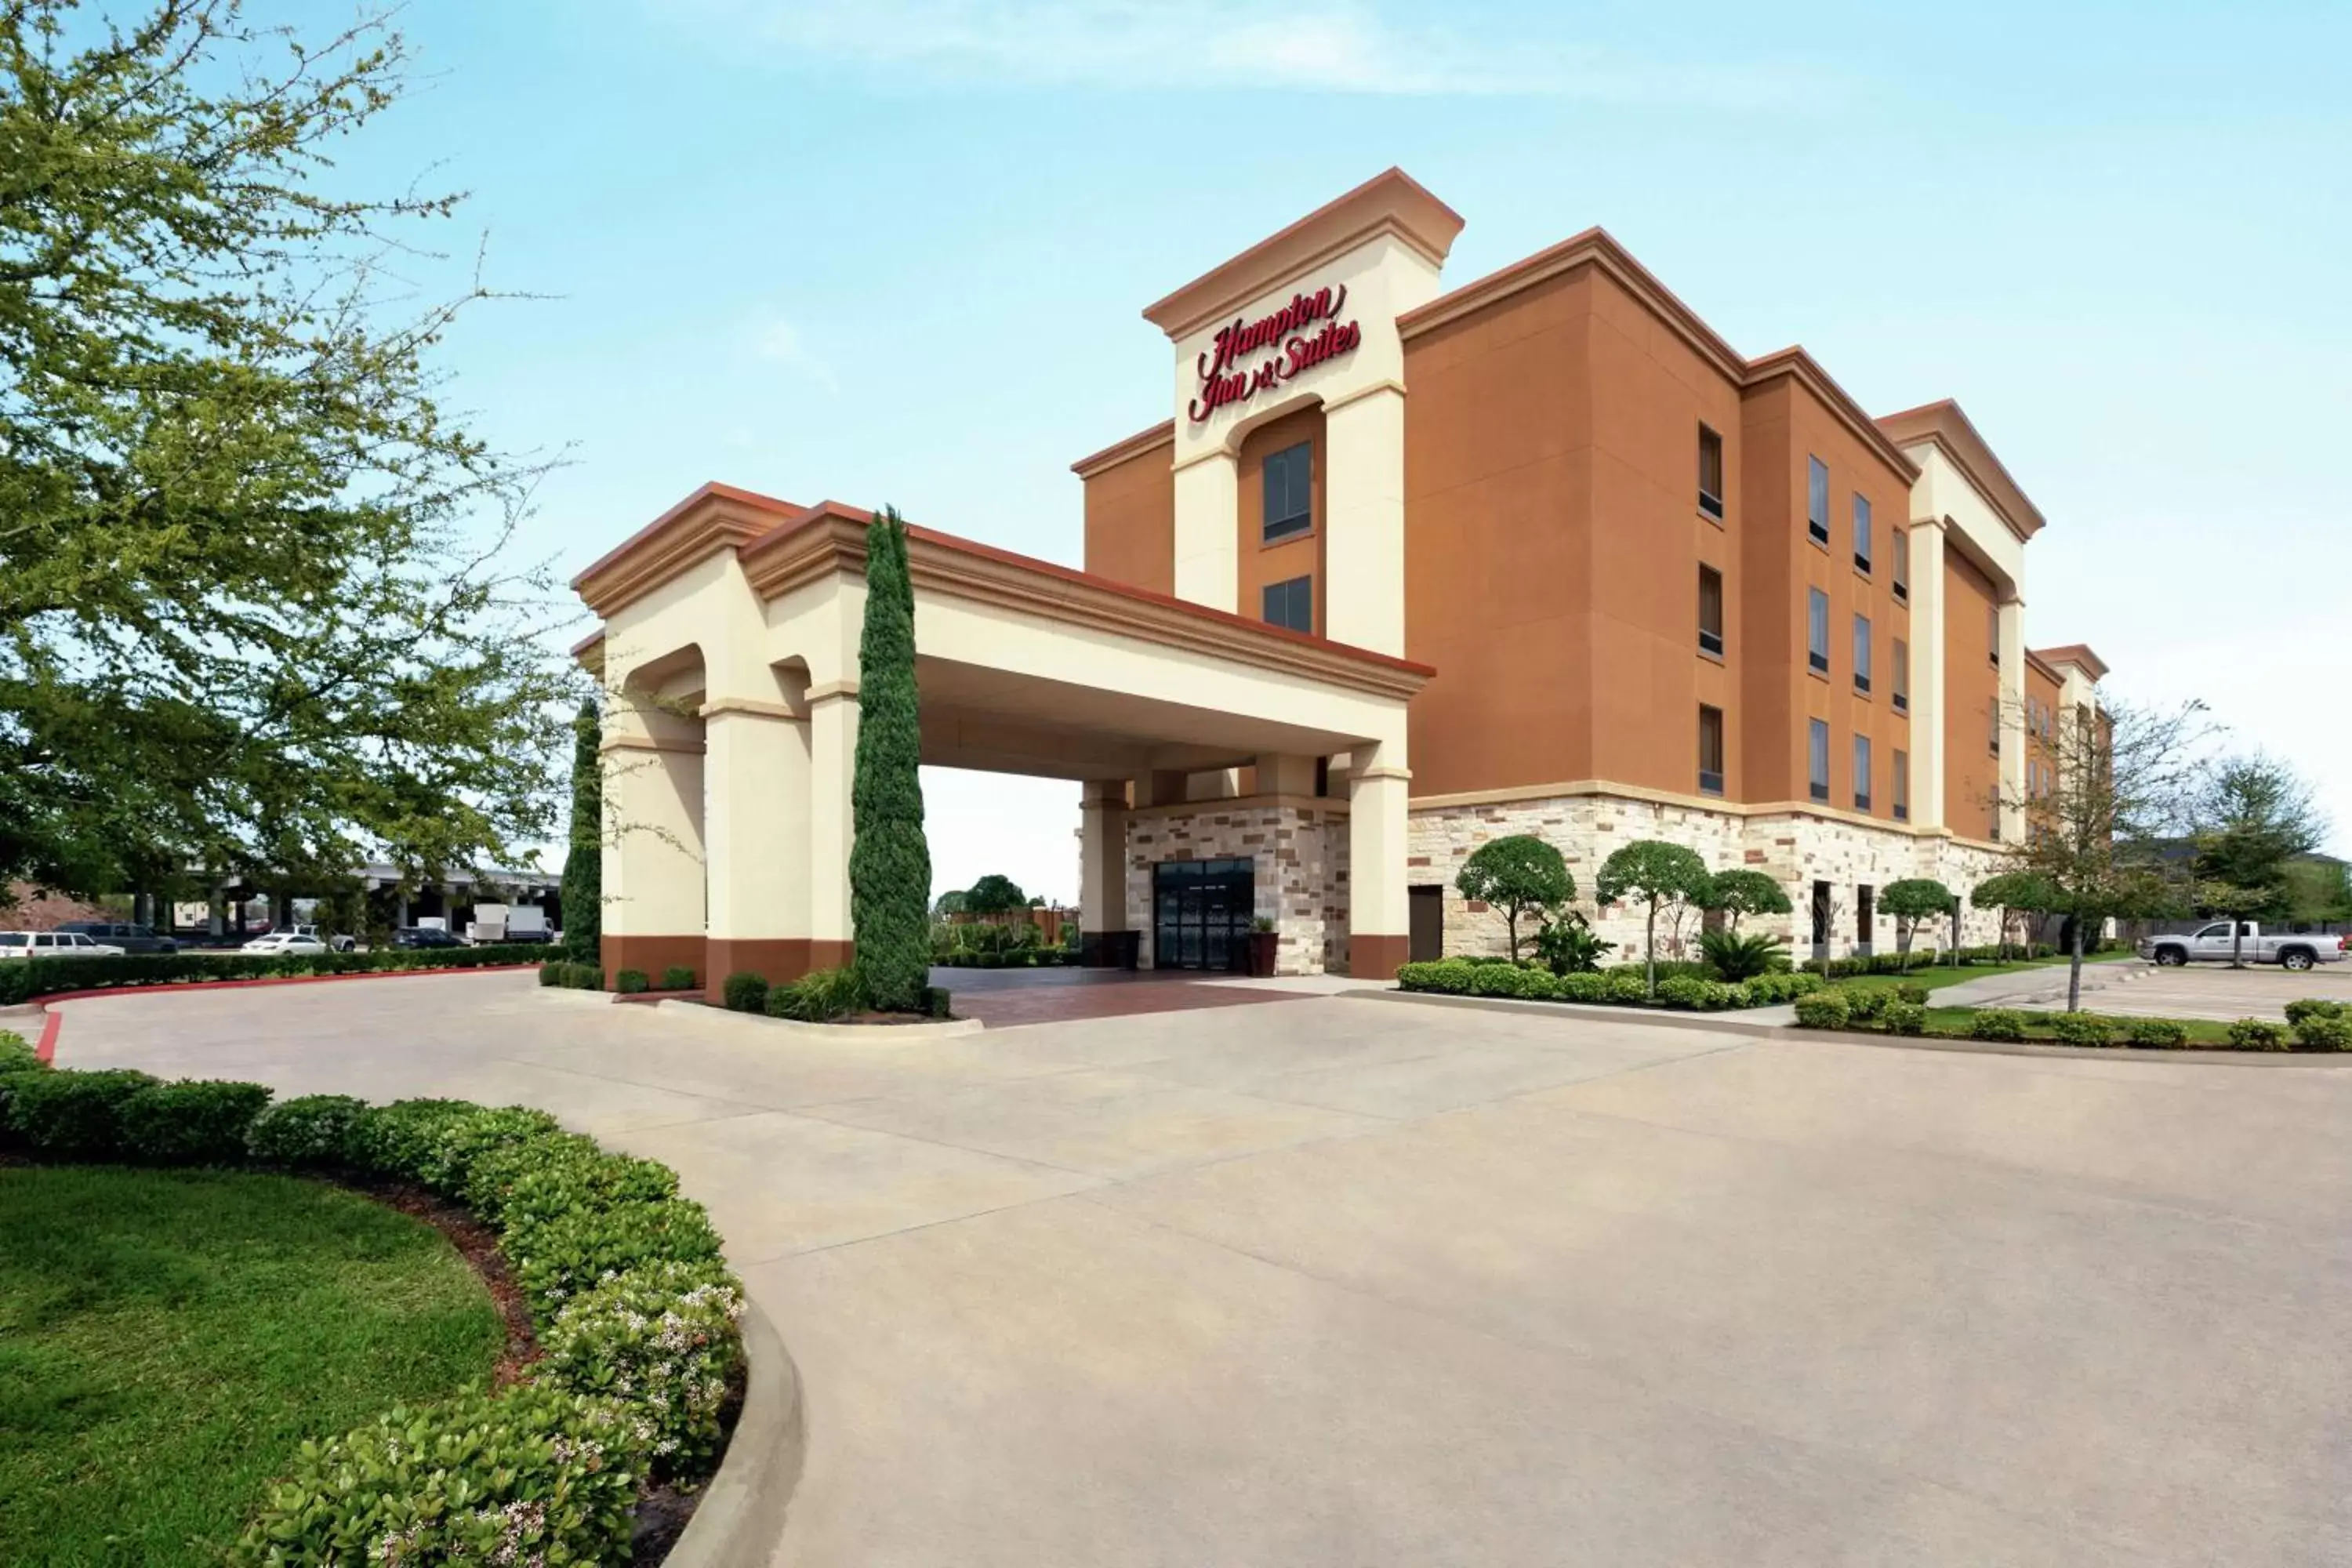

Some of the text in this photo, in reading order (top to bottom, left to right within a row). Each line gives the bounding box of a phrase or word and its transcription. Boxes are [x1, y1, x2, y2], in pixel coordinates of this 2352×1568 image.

[1189, 320, 1361, 422] Inn & Suites
[1198, 284, 1347, 380] Hampton
